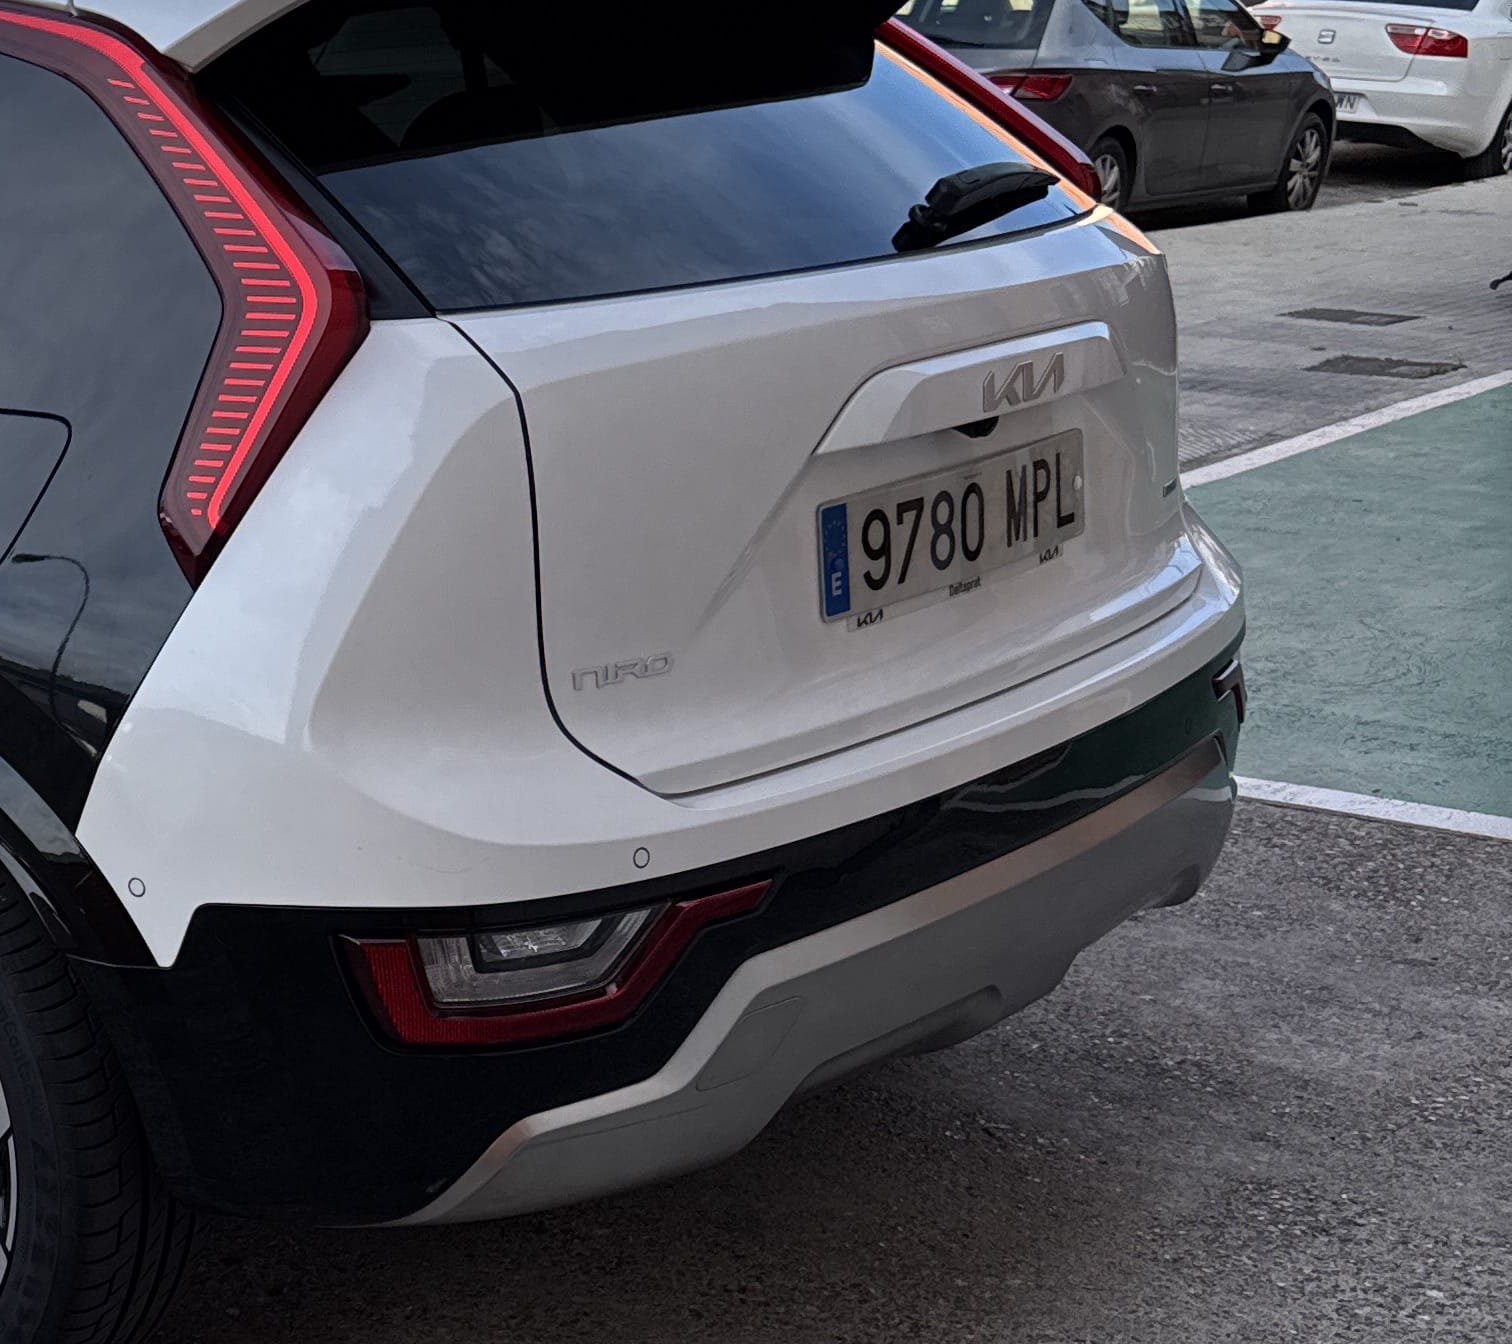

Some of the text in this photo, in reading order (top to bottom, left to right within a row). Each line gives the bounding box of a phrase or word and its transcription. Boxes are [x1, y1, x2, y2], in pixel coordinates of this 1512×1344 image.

[982, 351, 1065, 413] KIA
[861, 452, 1076, 591] 9780 MPL
[831, 571, 843, 597] E
[856, 608, 884, 628] KIA
[571, 652, 675, 691] NIRO
